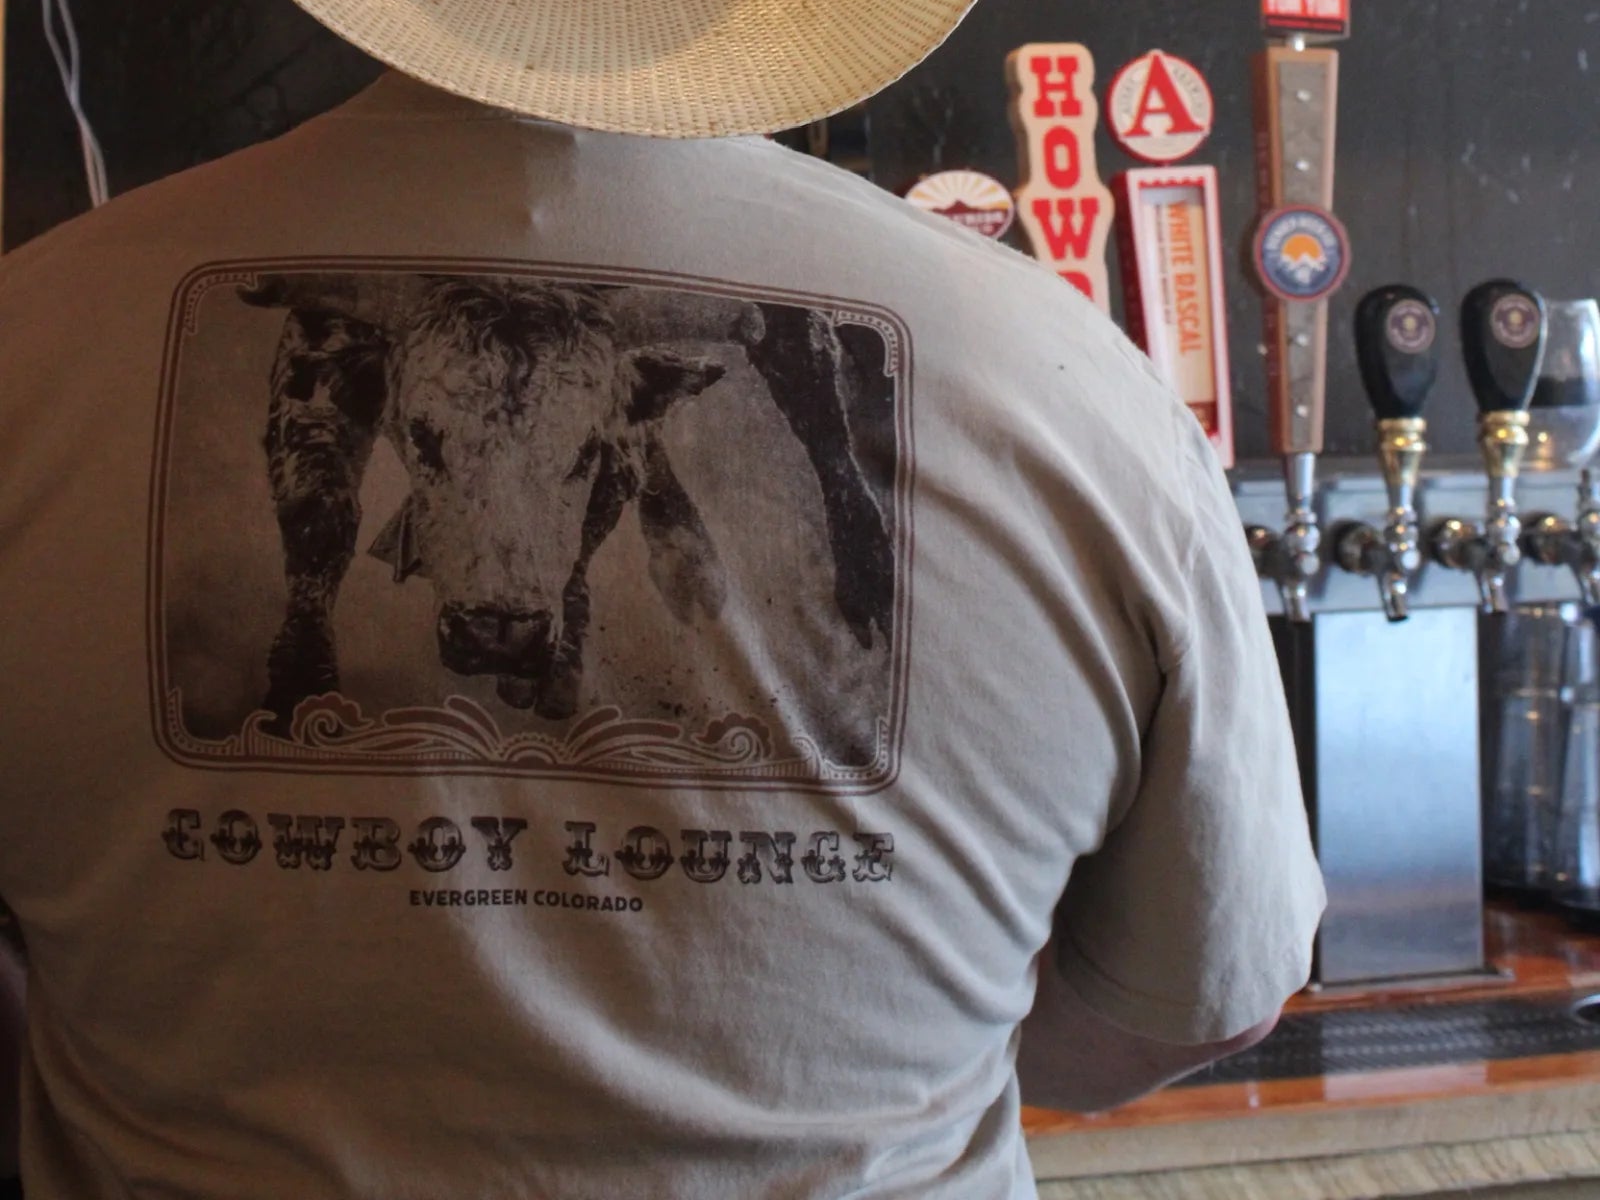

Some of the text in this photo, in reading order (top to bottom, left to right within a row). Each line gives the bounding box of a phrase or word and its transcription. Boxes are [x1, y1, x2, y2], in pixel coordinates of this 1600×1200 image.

[1121, 53, 1205, 138] A
[1030, 56, 1099, 302] HOW
[1167, 202, 1203, 355] WHITE RASCAL
[161, 808, 895, 885] COWBOY LOUNGE
[409, 889, 644, 912] EVERGREEN COLORADO
